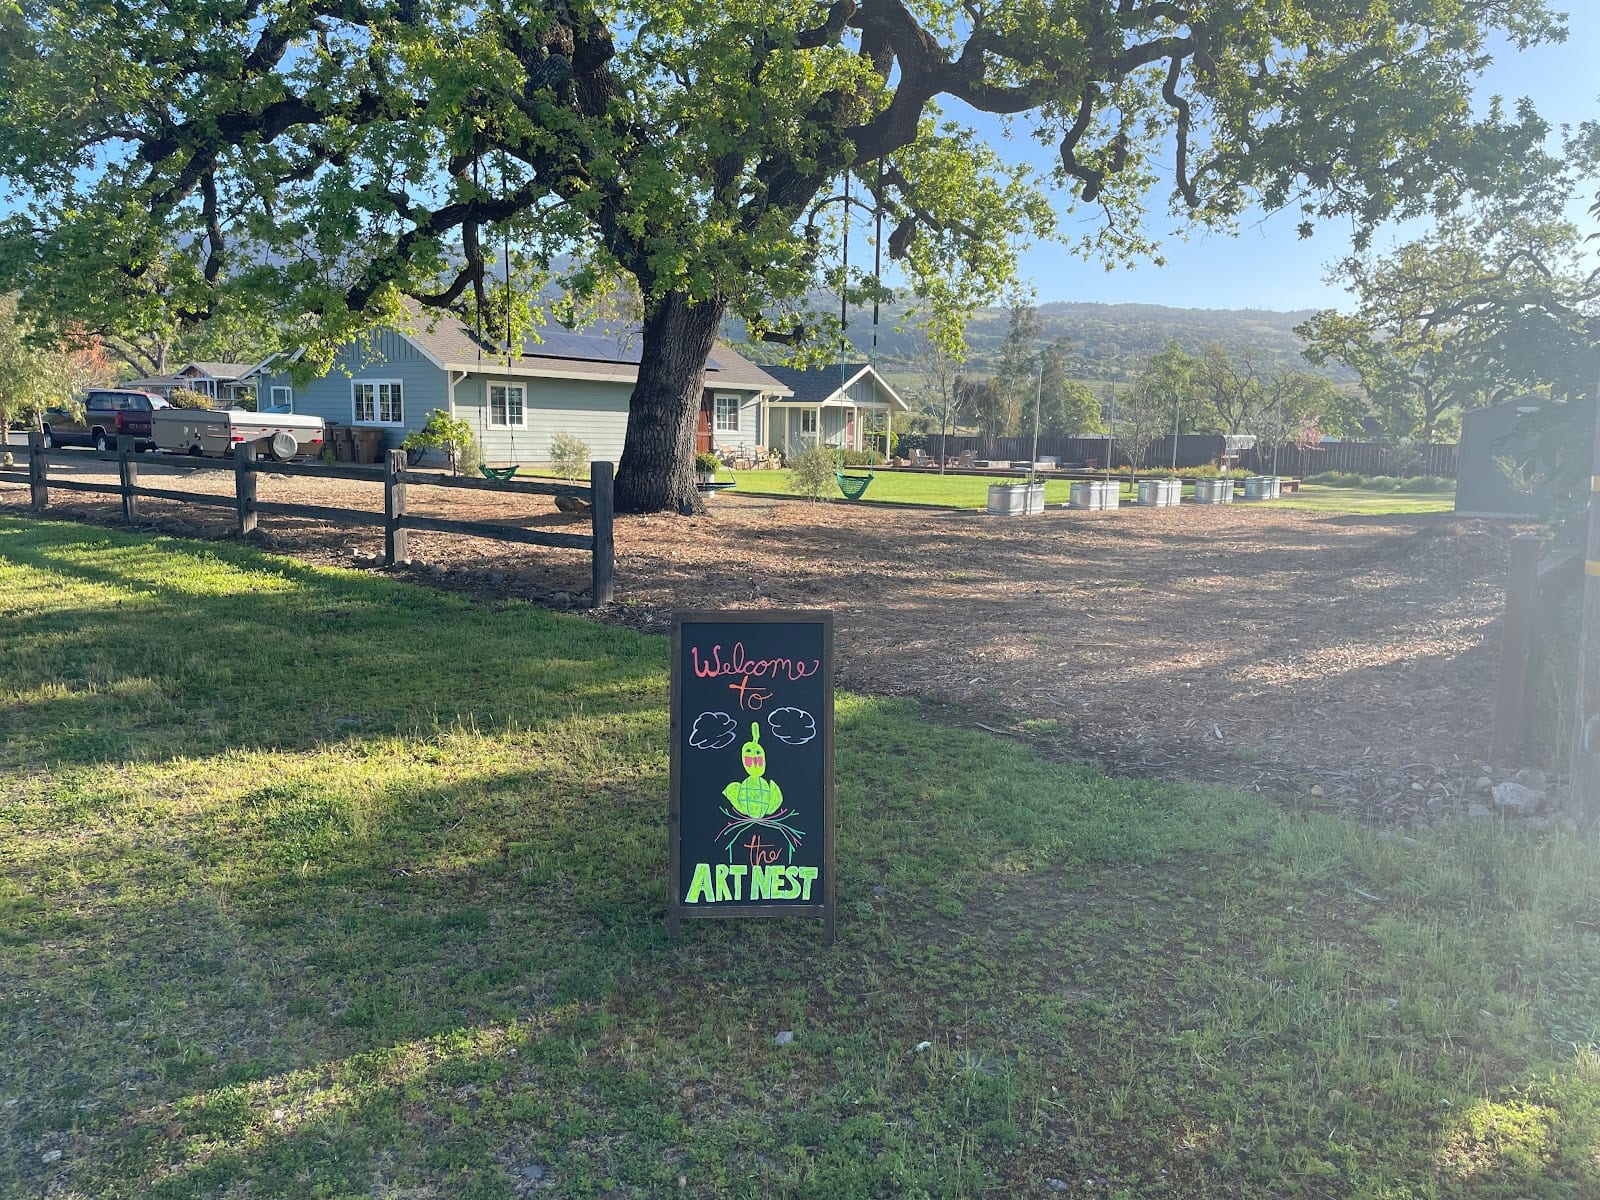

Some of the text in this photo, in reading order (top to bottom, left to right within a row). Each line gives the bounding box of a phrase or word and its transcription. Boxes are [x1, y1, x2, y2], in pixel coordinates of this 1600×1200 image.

[691, 642, 820, 681] Welcome
[729, 675, 773, 710] to
[744, 834, 782, 866] the
[685, 863, 818, 903] ART NEST
